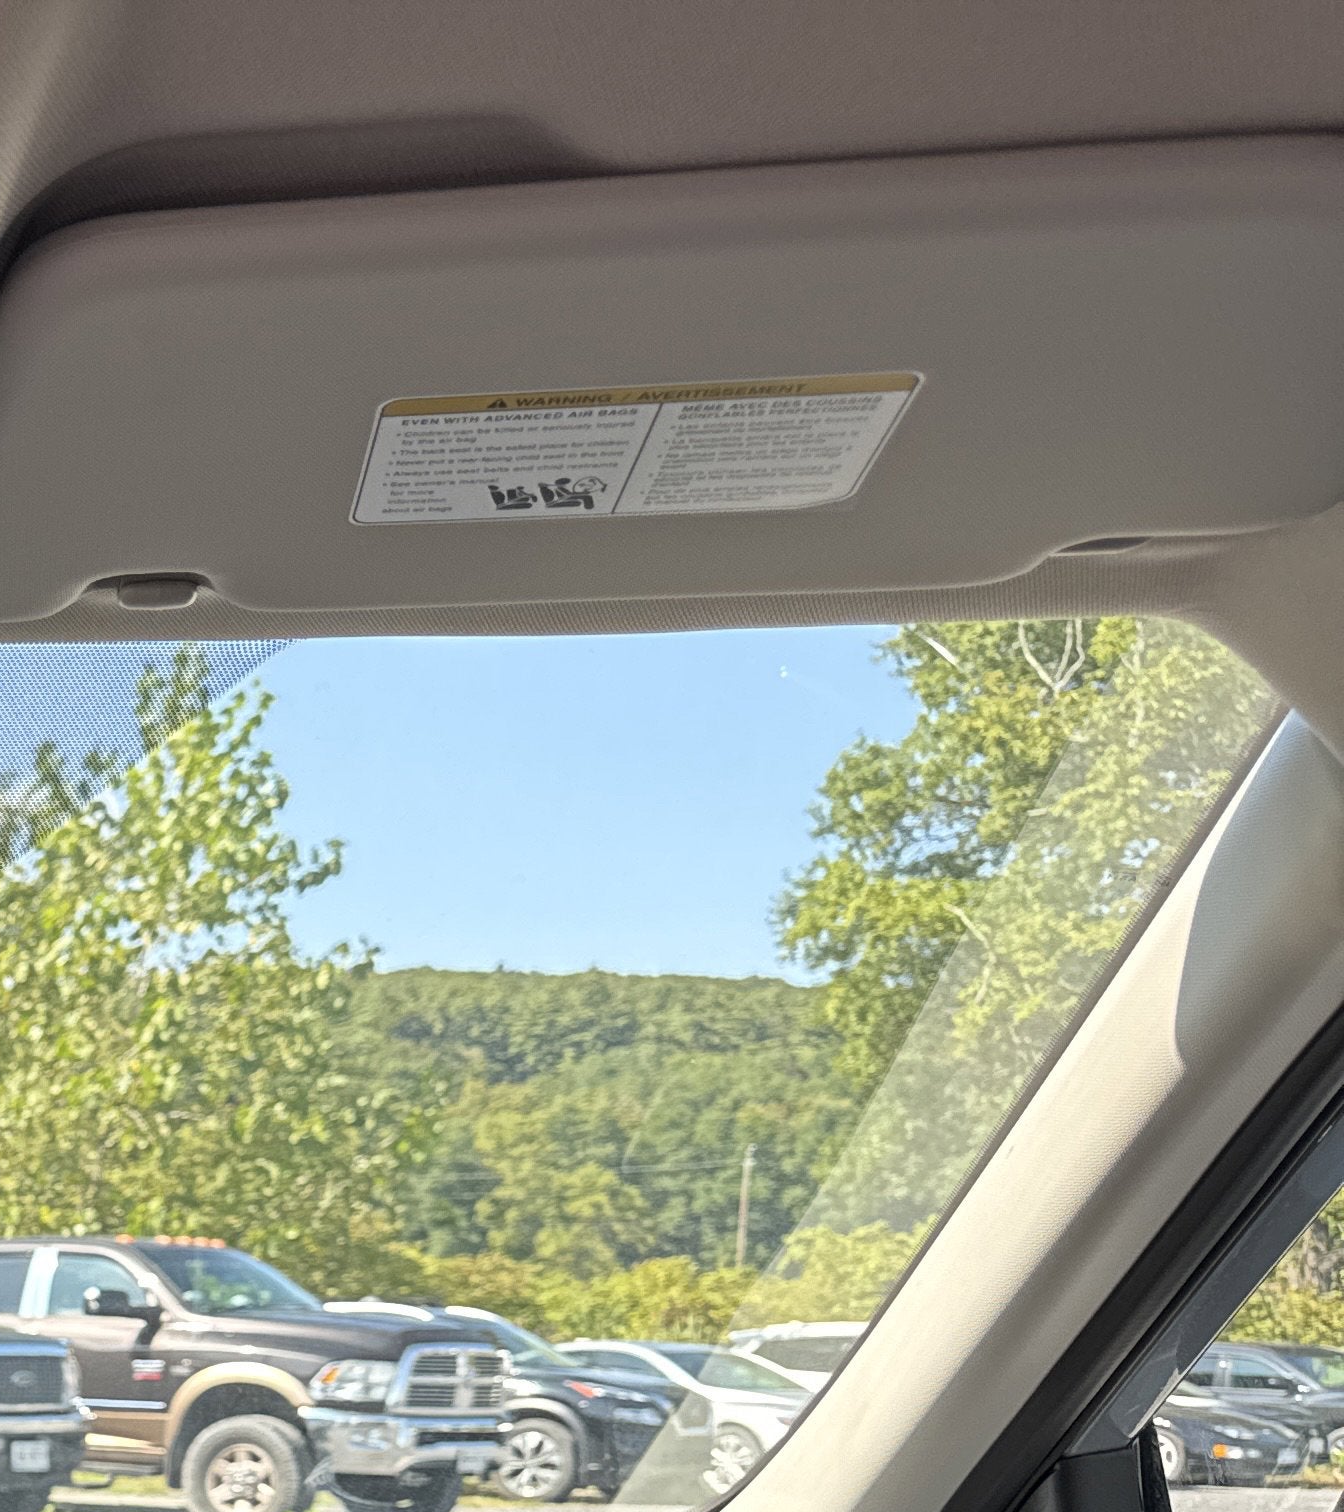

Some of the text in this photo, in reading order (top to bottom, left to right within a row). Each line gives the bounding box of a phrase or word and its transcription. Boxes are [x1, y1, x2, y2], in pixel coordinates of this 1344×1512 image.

[515, 383, 807, 407] WARNING AVERTISSEMENT
[401, 408, 638, 426] EVEN WITH ADVANCED AIR BAGS
